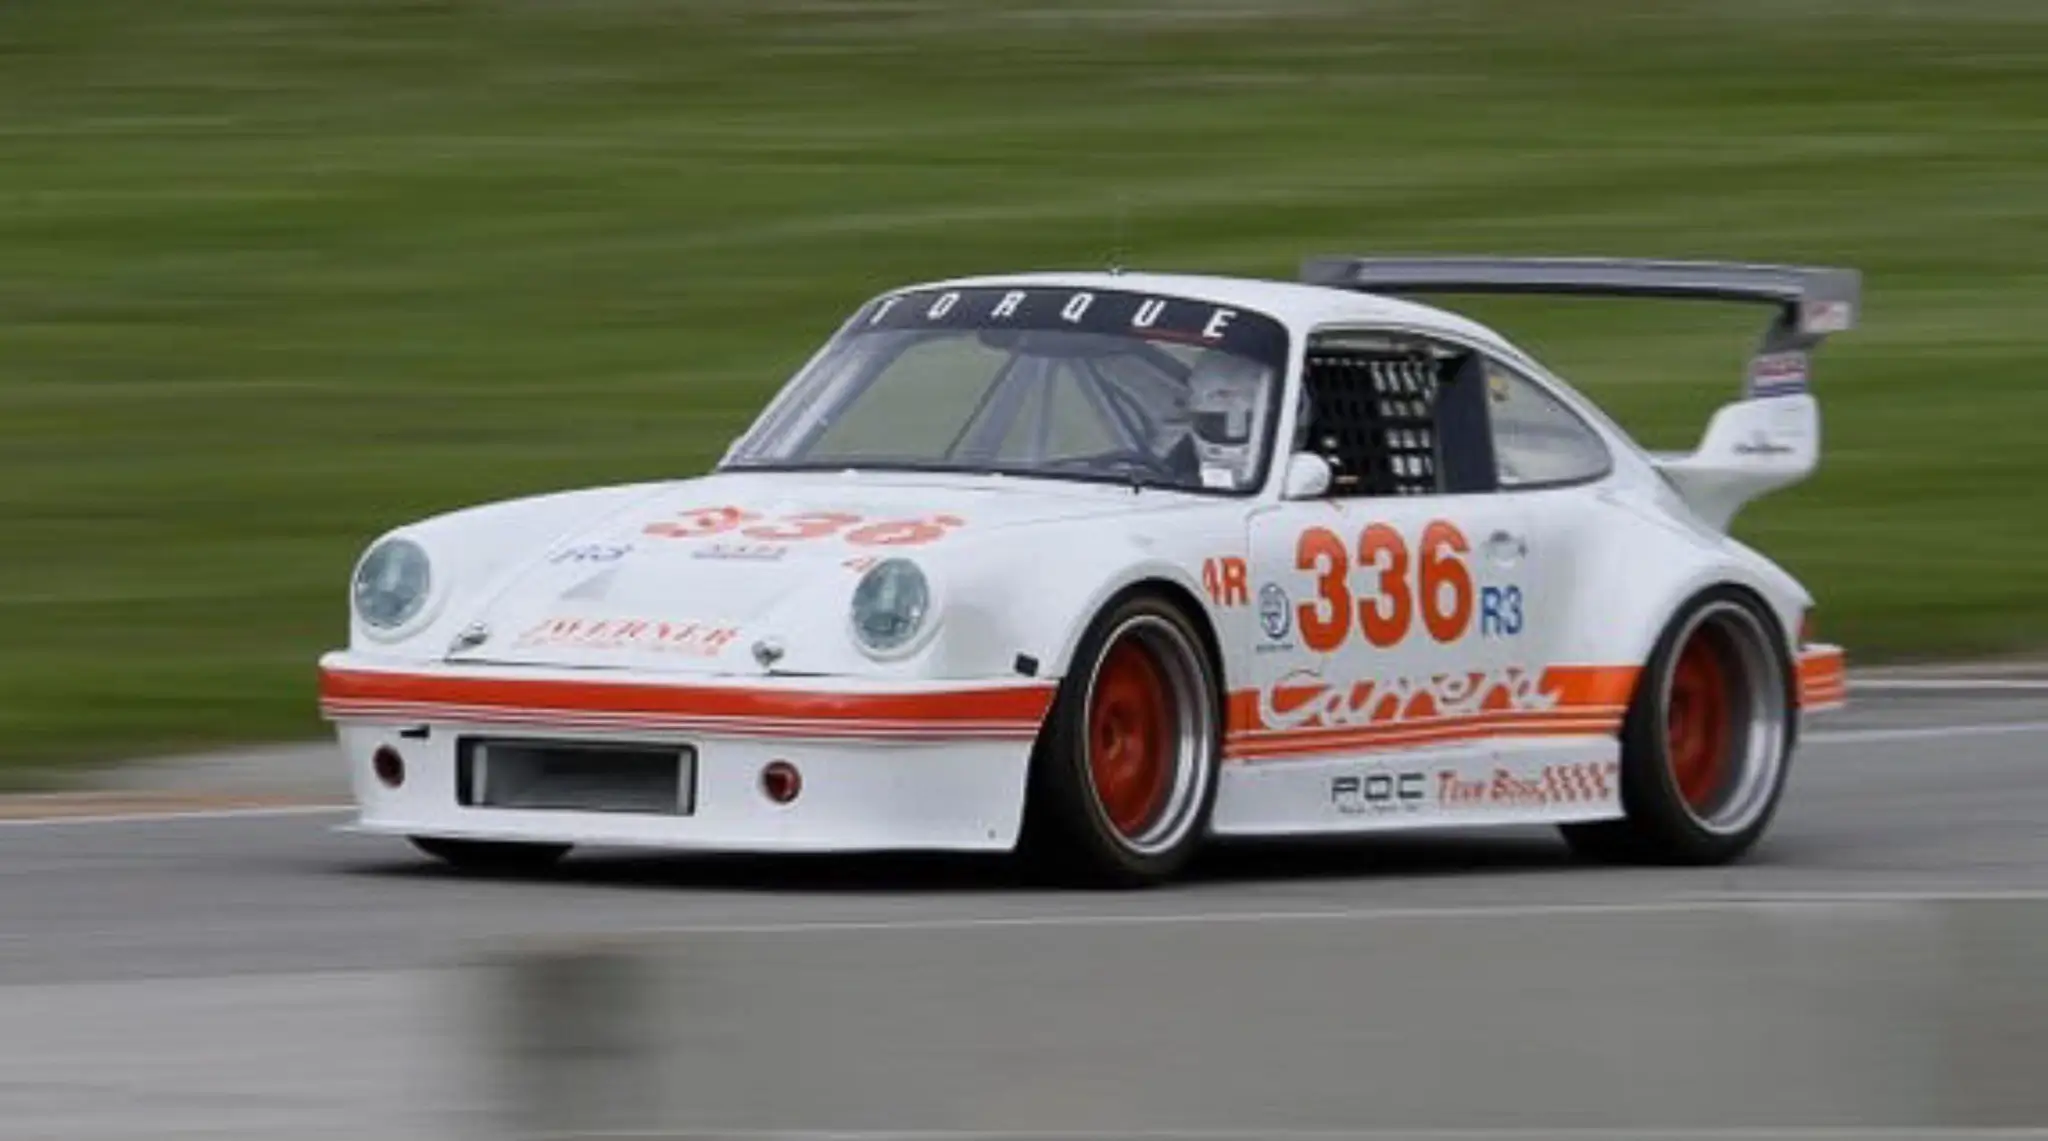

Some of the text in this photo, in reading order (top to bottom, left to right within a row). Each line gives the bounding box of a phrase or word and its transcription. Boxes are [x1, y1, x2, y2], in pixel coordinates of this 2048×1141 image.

[869, 291, 1237, 339] TORQUE
[642, 505, 966, 547] 336
[1296, 518, 1473, 653] 336
[1480, 586, 1524, 636] R3
[1257, 667, 1562, 730] Carrera
[1331, 772, 1425, 803] POC
